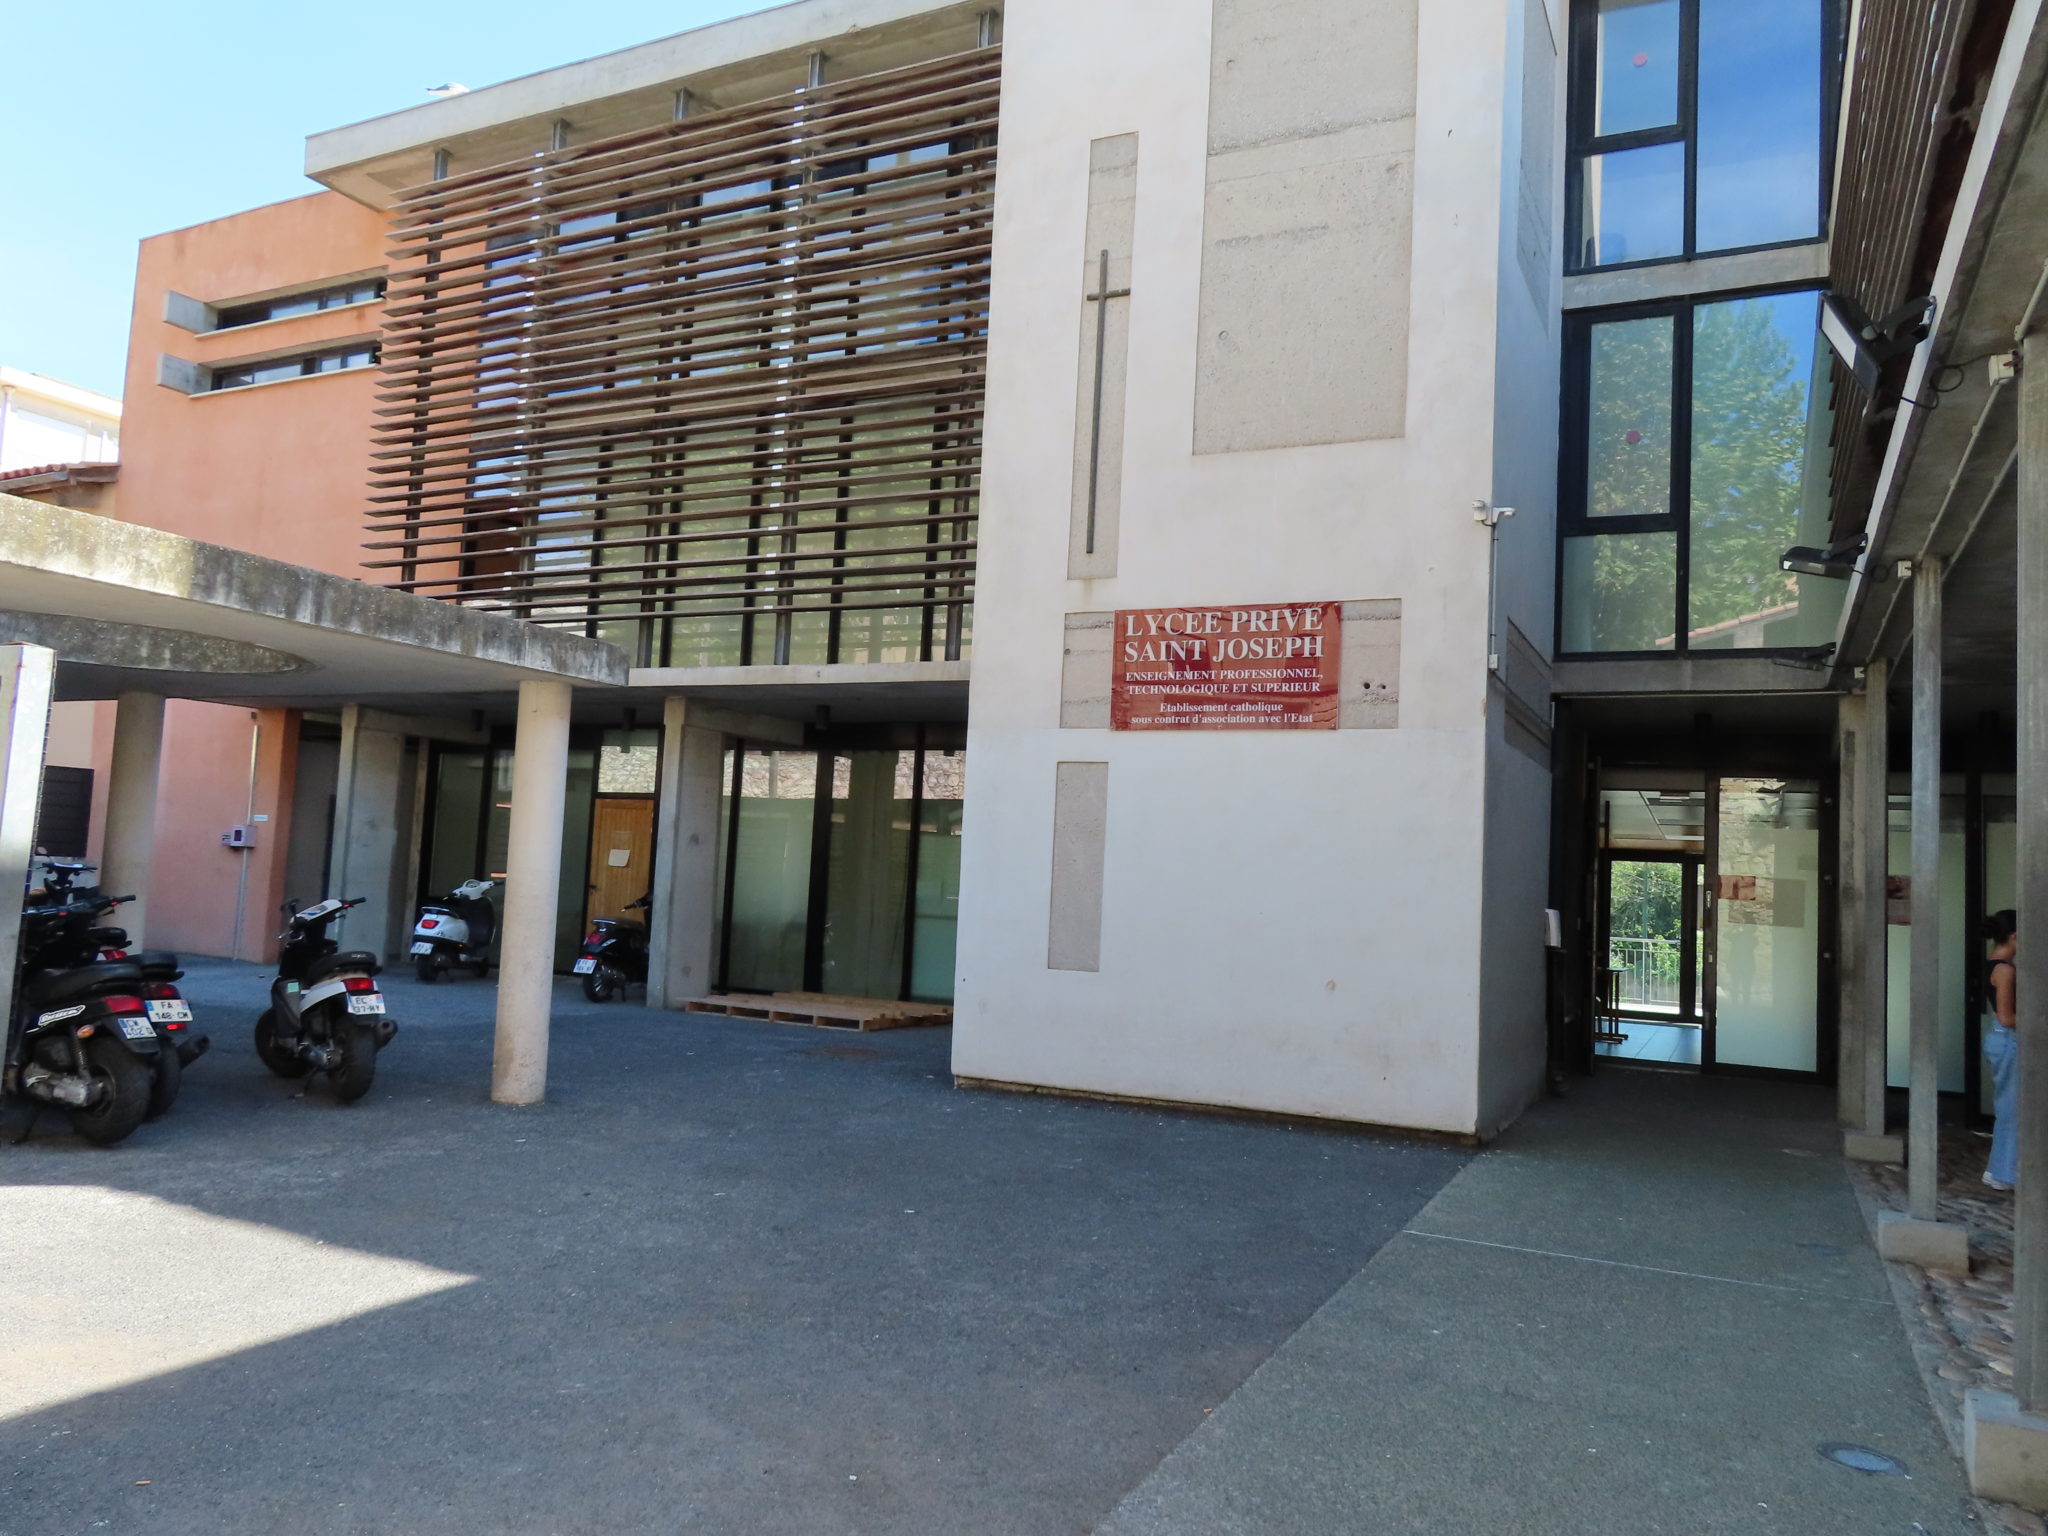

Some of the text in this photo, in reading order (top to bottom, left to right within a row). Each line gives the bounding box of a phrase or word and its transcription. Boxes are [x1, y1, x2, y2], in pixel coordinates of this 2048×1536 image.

[1125, 607, 1323, 636] LYCEE PRIVE
[1124, 635, 1324, 662] SAINT JOSEPH
[1125, 668, 1324, 682] ENSEIGNEMENT PROFESSIONNEL,
[1128, 682, 1320, 695] TECHNOLOGIQUE ET SUPERIEUR
[1160, 702, 1283, 713] Etablissement catholique
[1131, 713, 1313, 724] sous contrat d'association avec l'Etat
